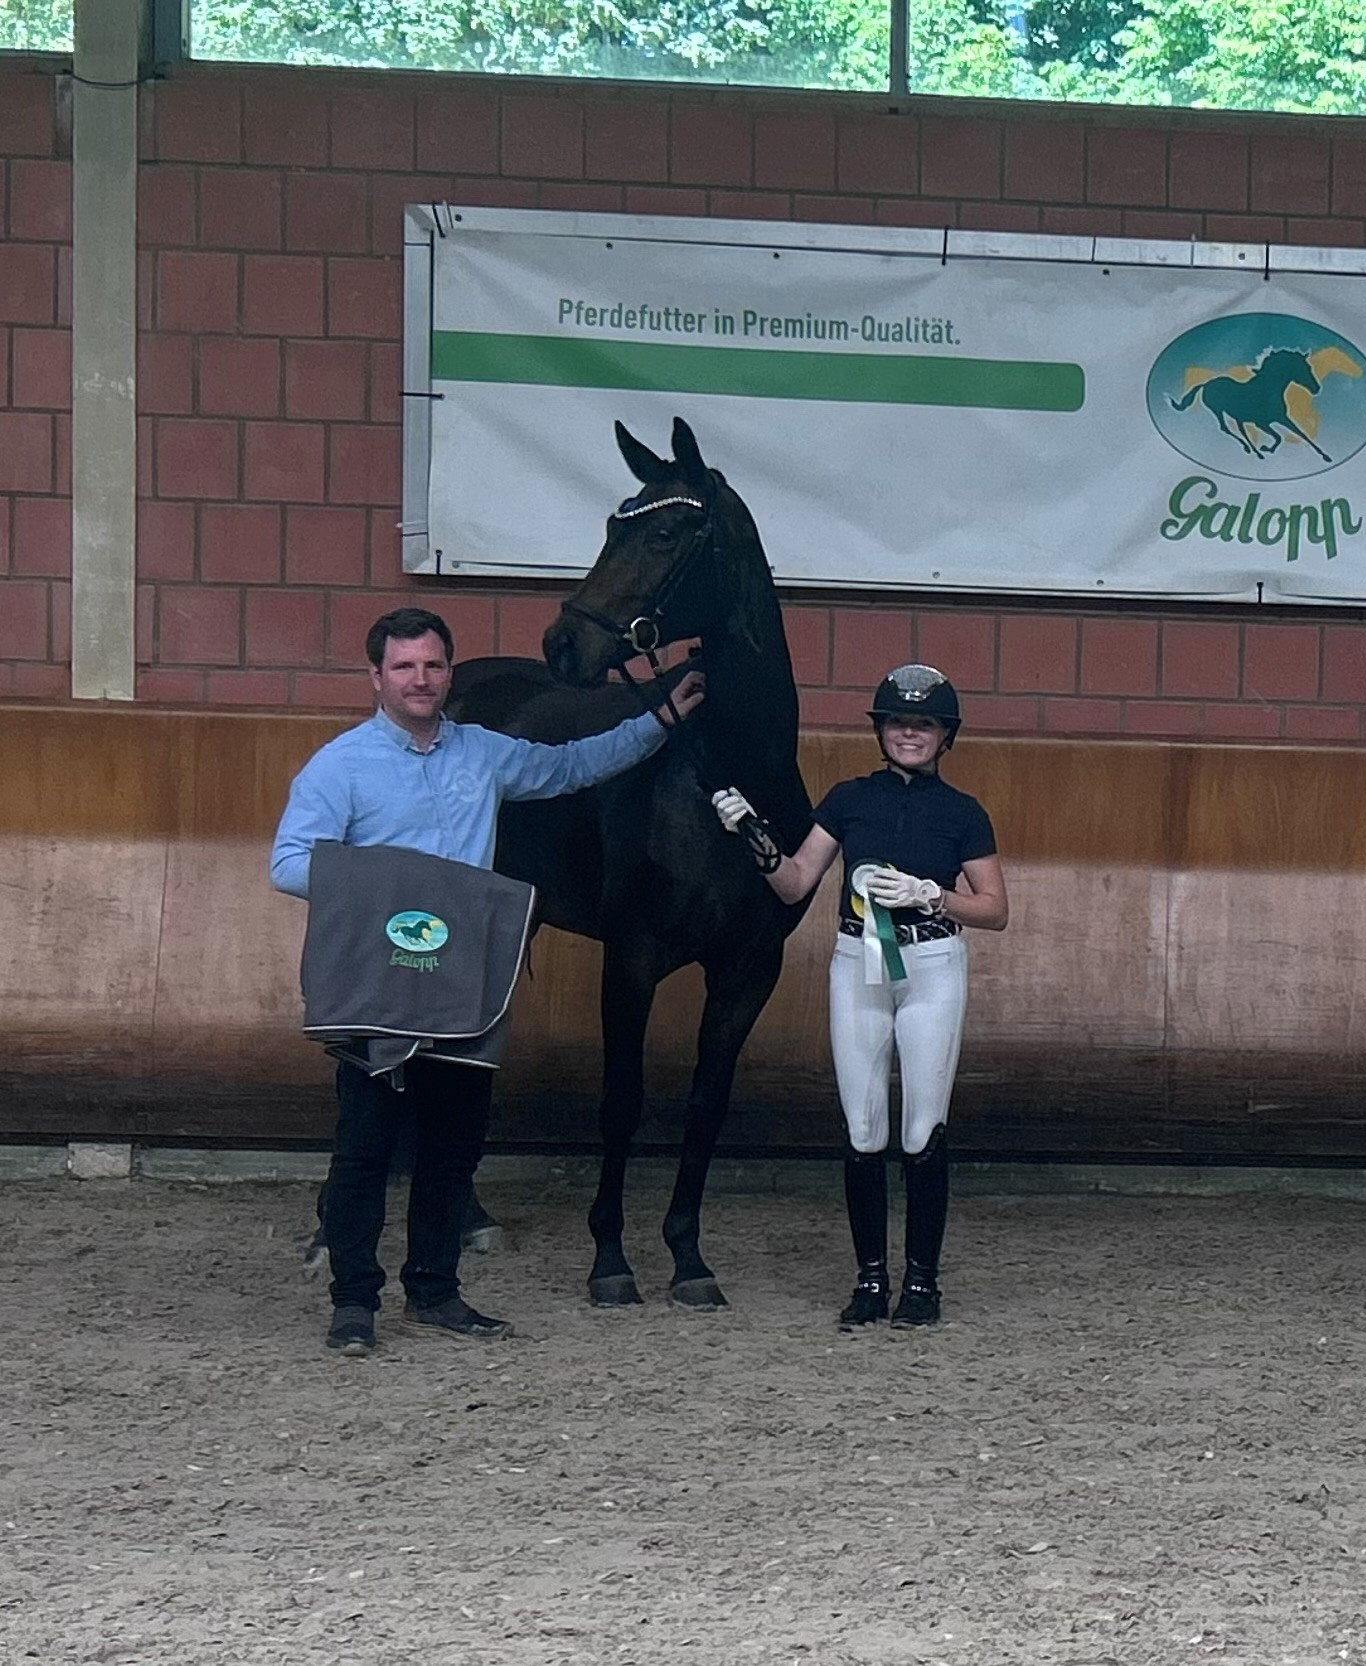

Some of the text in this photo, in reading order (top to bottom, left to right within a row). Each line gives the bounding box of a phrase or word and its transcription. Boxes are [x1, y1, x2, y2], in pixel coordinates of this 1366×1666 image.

[557, 298, 961, 346] Pferdefutter in Premium-Qualität.
[1160, 475, 1362, 562] Galopp
[389, 948, 440, 972] Galopp
